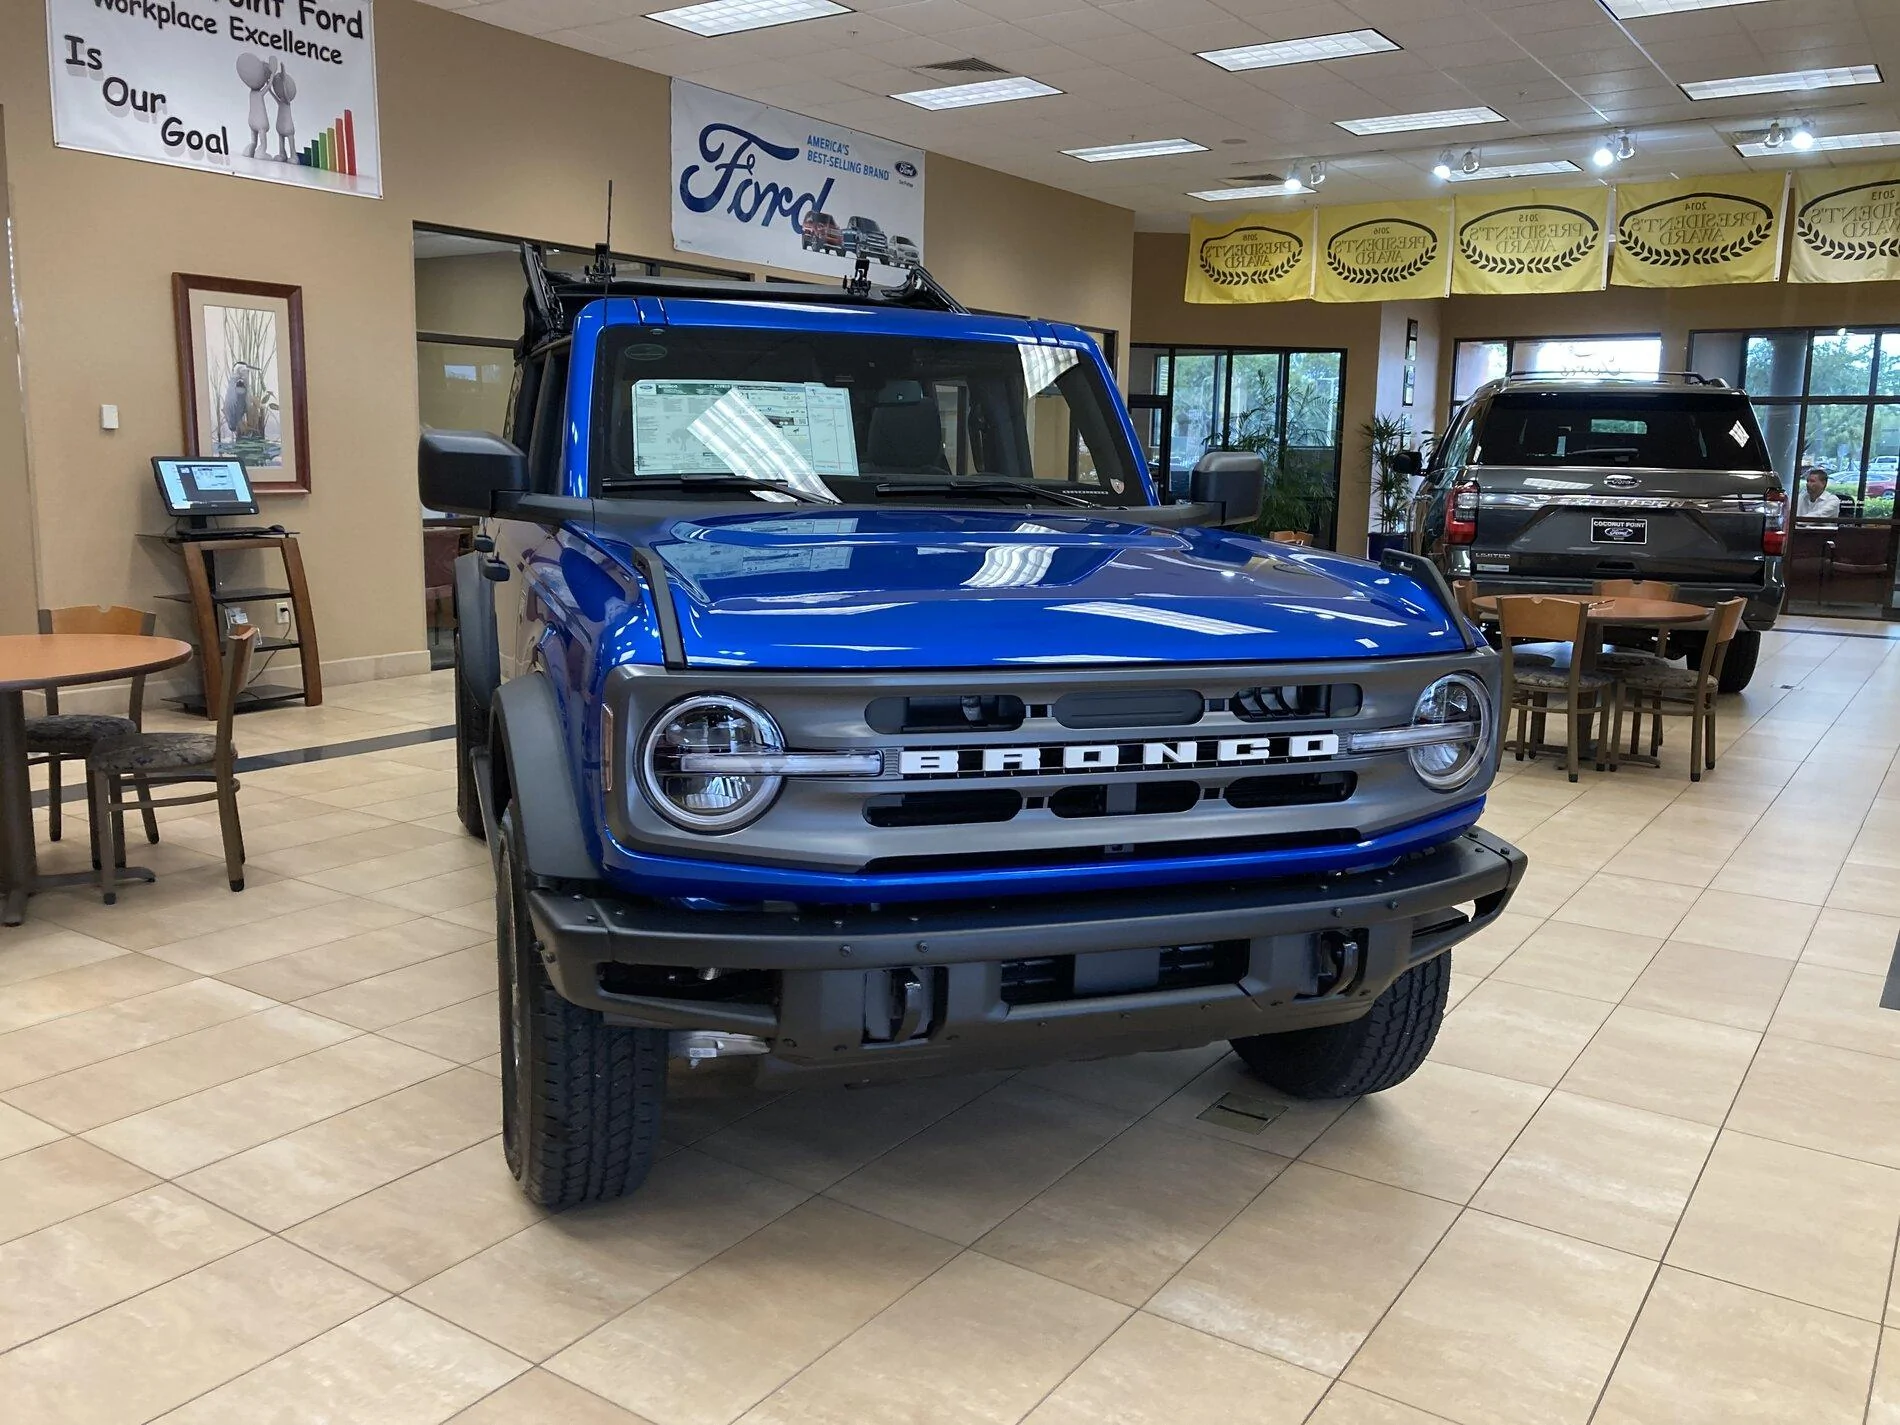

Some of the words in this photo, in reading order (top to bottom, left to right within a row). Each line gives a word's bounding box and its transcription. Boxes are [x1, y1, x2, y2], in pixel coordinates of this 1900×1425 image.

[298, 0, 363, 39] Ford
[64, 35, 103, 70] Is
[229, 16, 343, 65] Excellence
[103, 77, 166, 113] Our
[161, 117, 230, 155] Goal
[807, 134, 850, 156] AMERICA'S
[680, 123, 835, 234] Ford
[807, 150, 861, 174] BEST-SELLING
[863, 164, 890, 181] BRAND
[1608, 528, 1630, 537] Ford
[900, 733, 1339, 774] BRONCO
